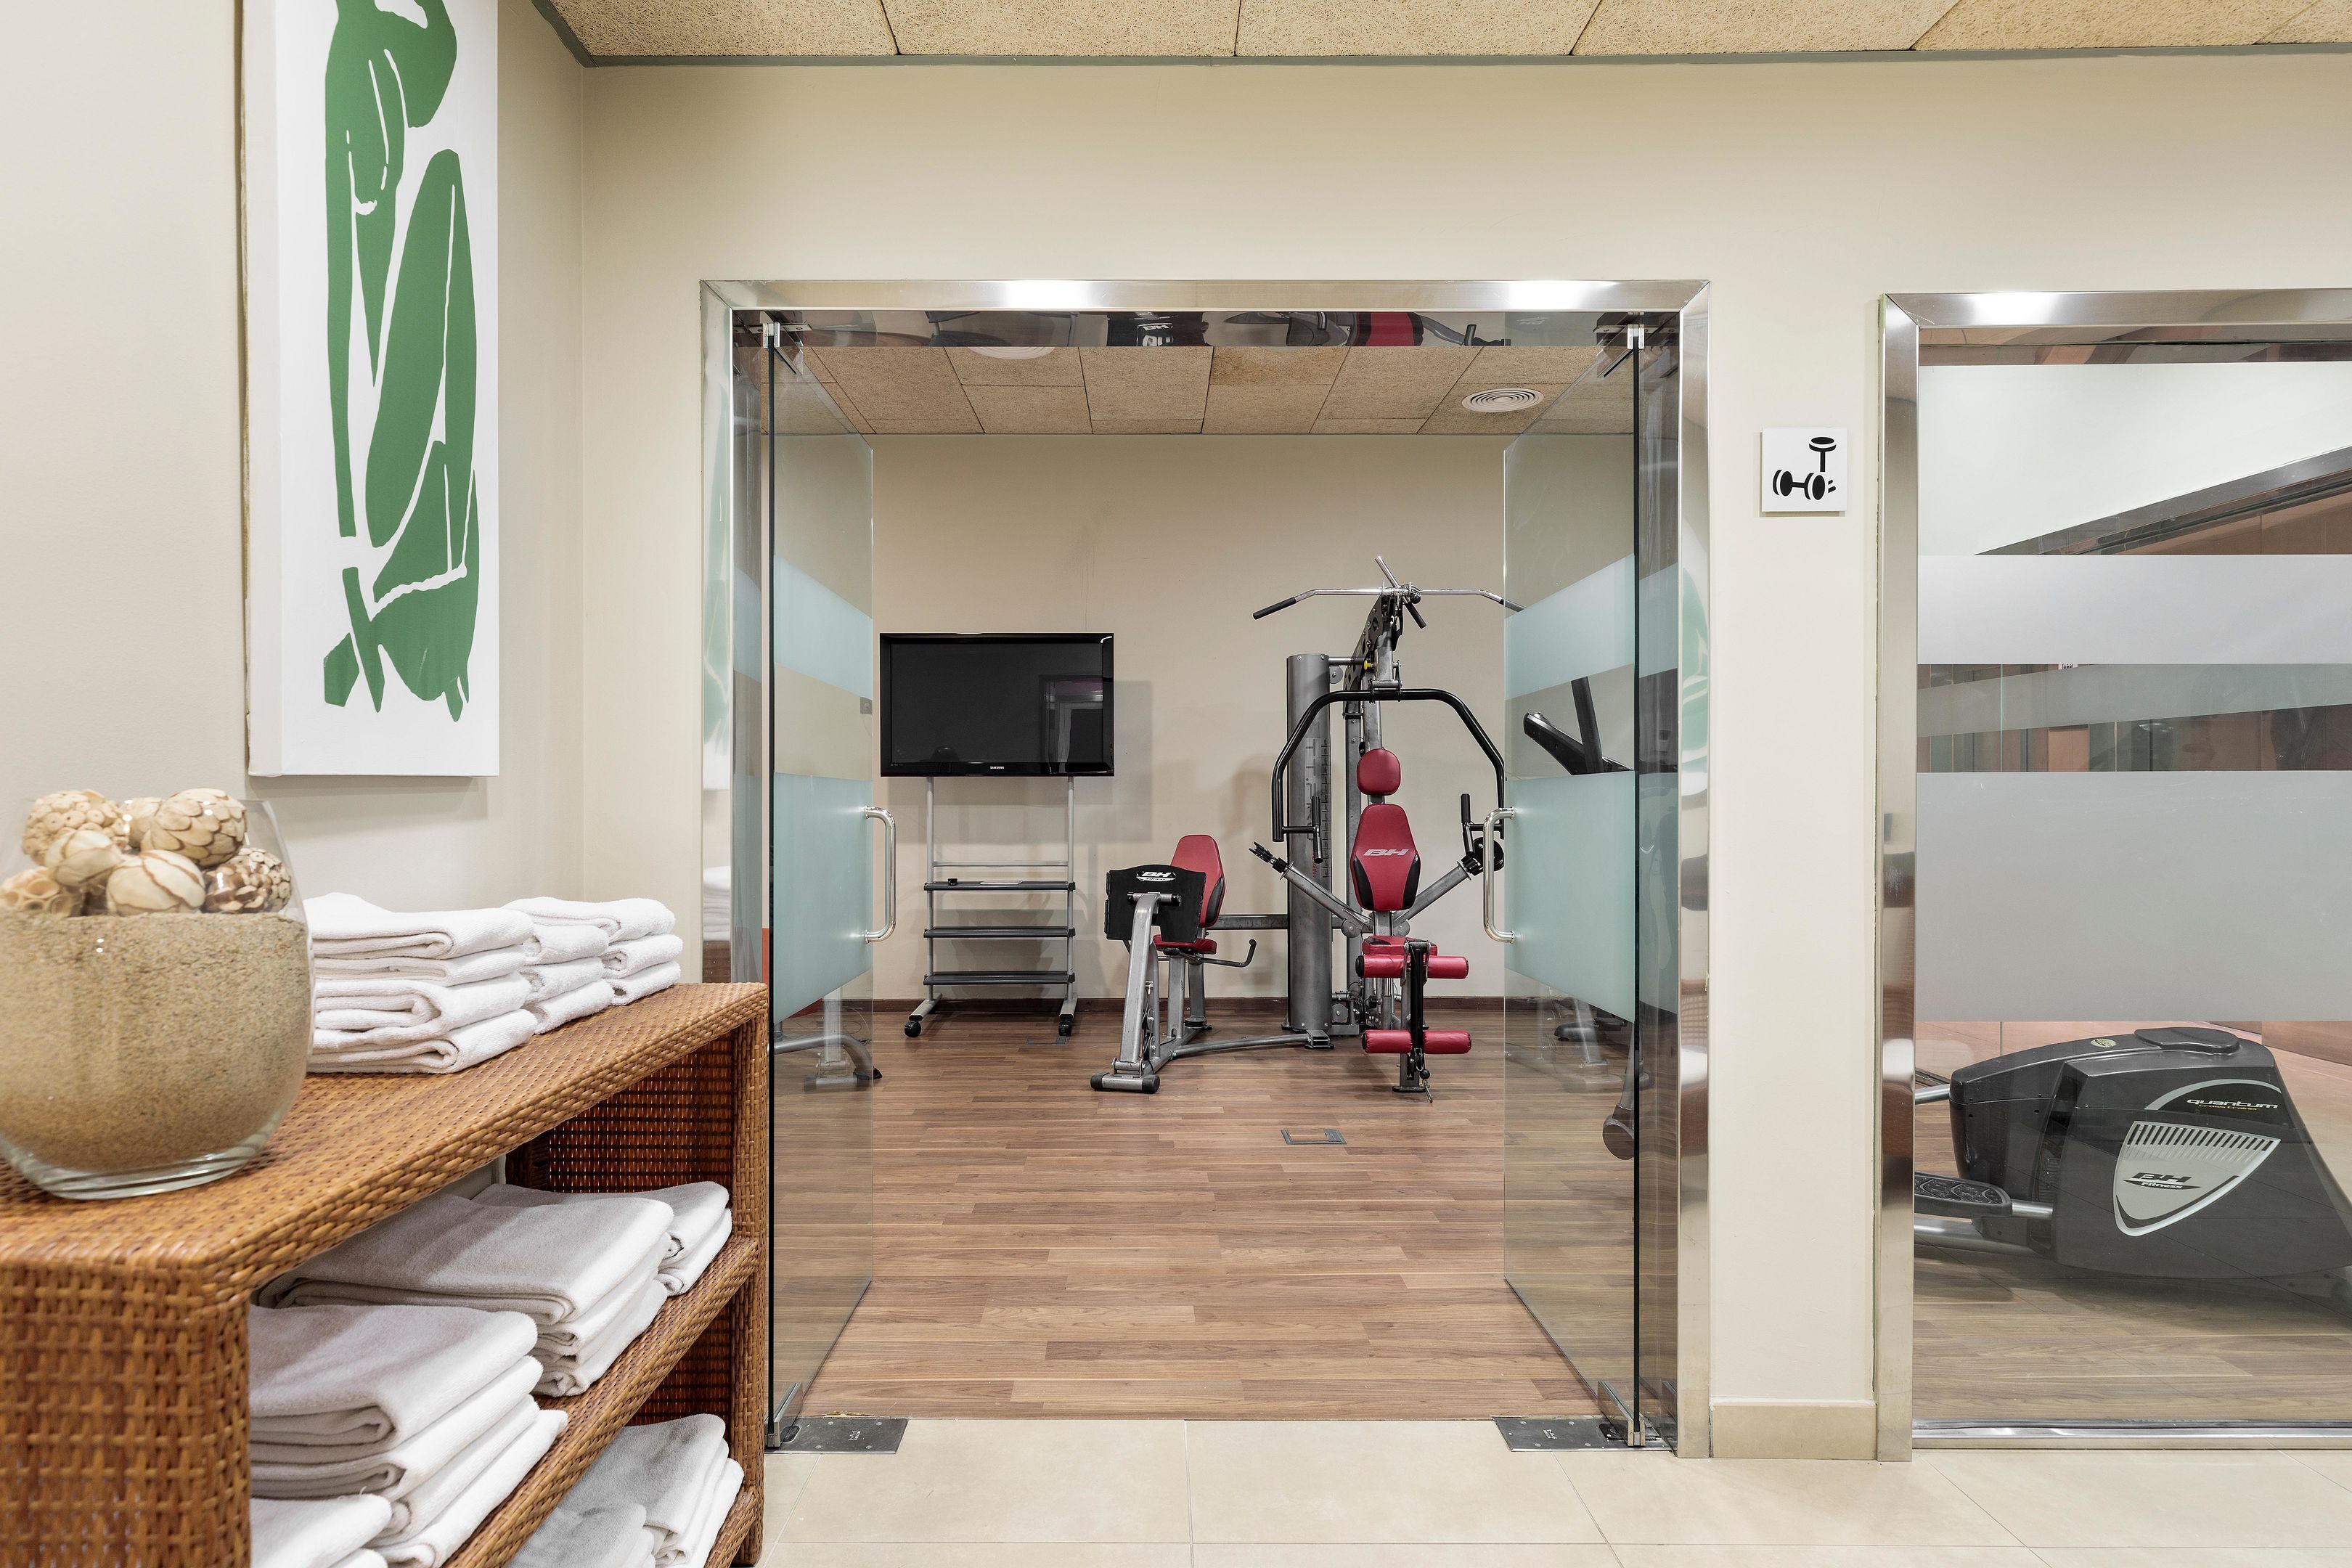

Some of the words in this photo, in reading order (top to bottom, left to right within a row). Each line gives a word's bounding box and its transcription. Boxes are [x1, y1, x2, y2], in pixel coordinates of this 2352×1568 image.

[2186, 1099, 2279, 1109] quantum
[2131, 1172, 2192, 1183] BH
[2141, 1181, 2183, 1190] Fitness
